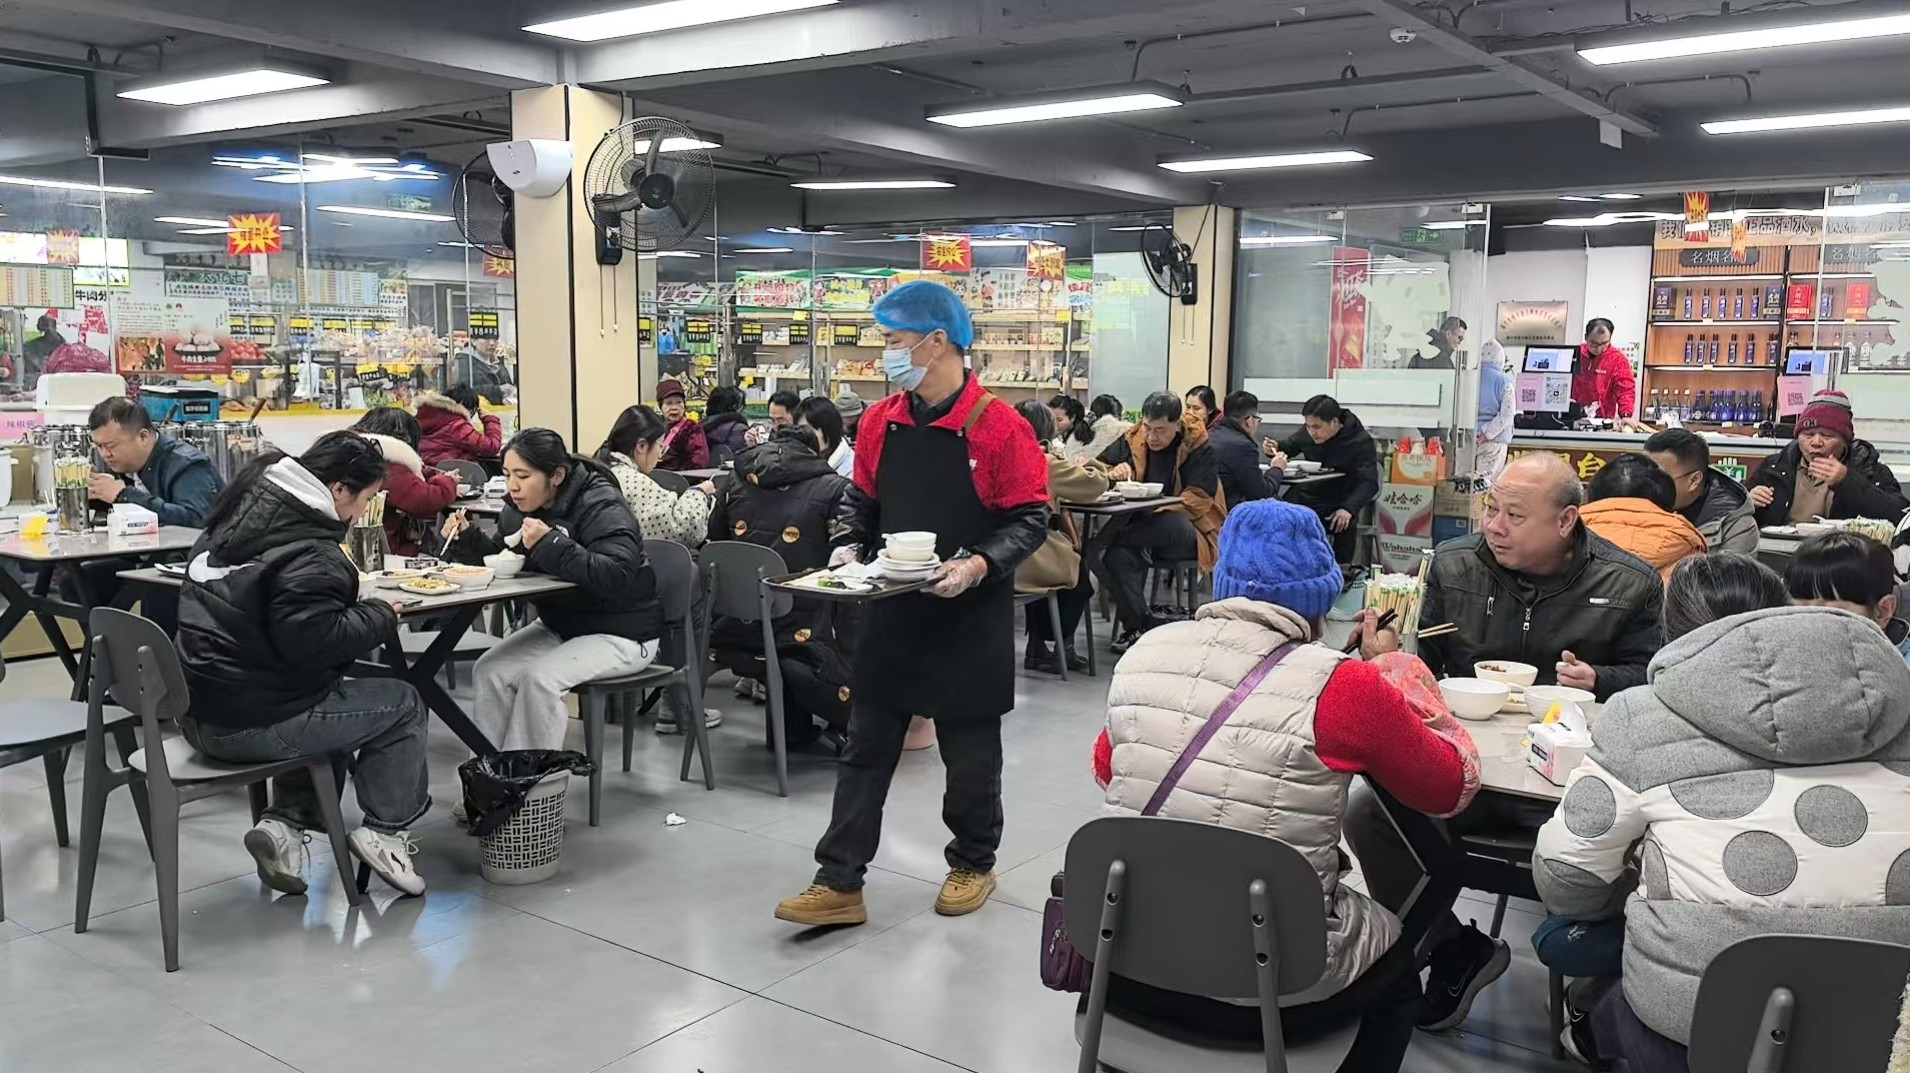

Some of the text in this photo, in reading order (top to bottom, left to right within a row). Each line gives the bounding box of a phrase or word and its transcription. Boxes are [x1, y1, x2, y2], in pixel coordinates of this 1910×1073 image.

[1690, 250, 1747, 264] 名烟名
[75, 289, 114, 302] 牛肉分
[1383, 491, 1423, 505] 娃哈哈
